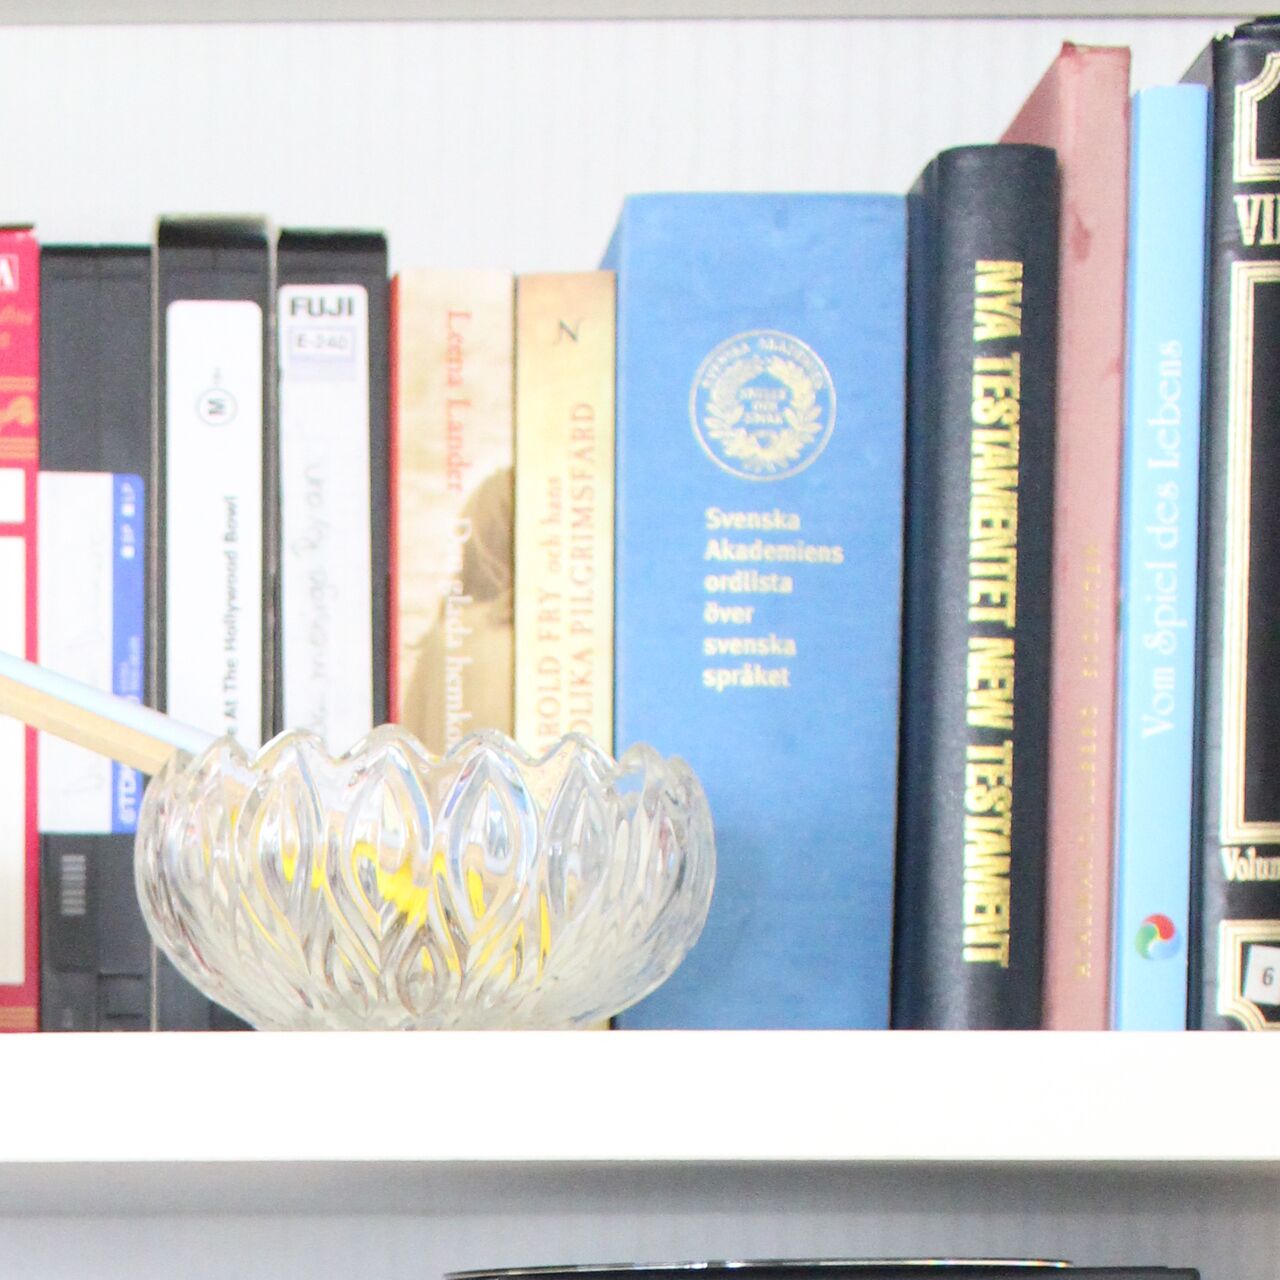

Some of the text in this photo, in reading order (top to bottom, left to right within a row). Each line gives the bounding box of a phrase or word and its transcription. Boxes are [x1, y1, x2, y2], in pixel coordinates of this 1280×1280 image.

[1233, 194, 1280, 246] VI
[290, 296, 355, 317] FUJI
[1147, 338, 1183, 470] Lebens
[446, 399, 473, 493] Lander
[222, 495, 239, 543] Bowl
[705, 507, 801, 531] Svenska
[1145, 480, 1180, 550] des
[704, 538, 845, 565] Akademiens
[222, 549, 243, 652] Hollywood
[704, 570, 793, 593] ordlista
[535, 586, 562, 642] FRY
[704, 601, 754, 624] över
[962, 259, 1024, 969] NYA TESTAMENTET NEW TESTAMENT
[703, 633, 796, 656] svenska
[222, 658, 239, 693] The
[703, 664, 790, 692] språket
[1141, 664, 1177, 738] Vom
